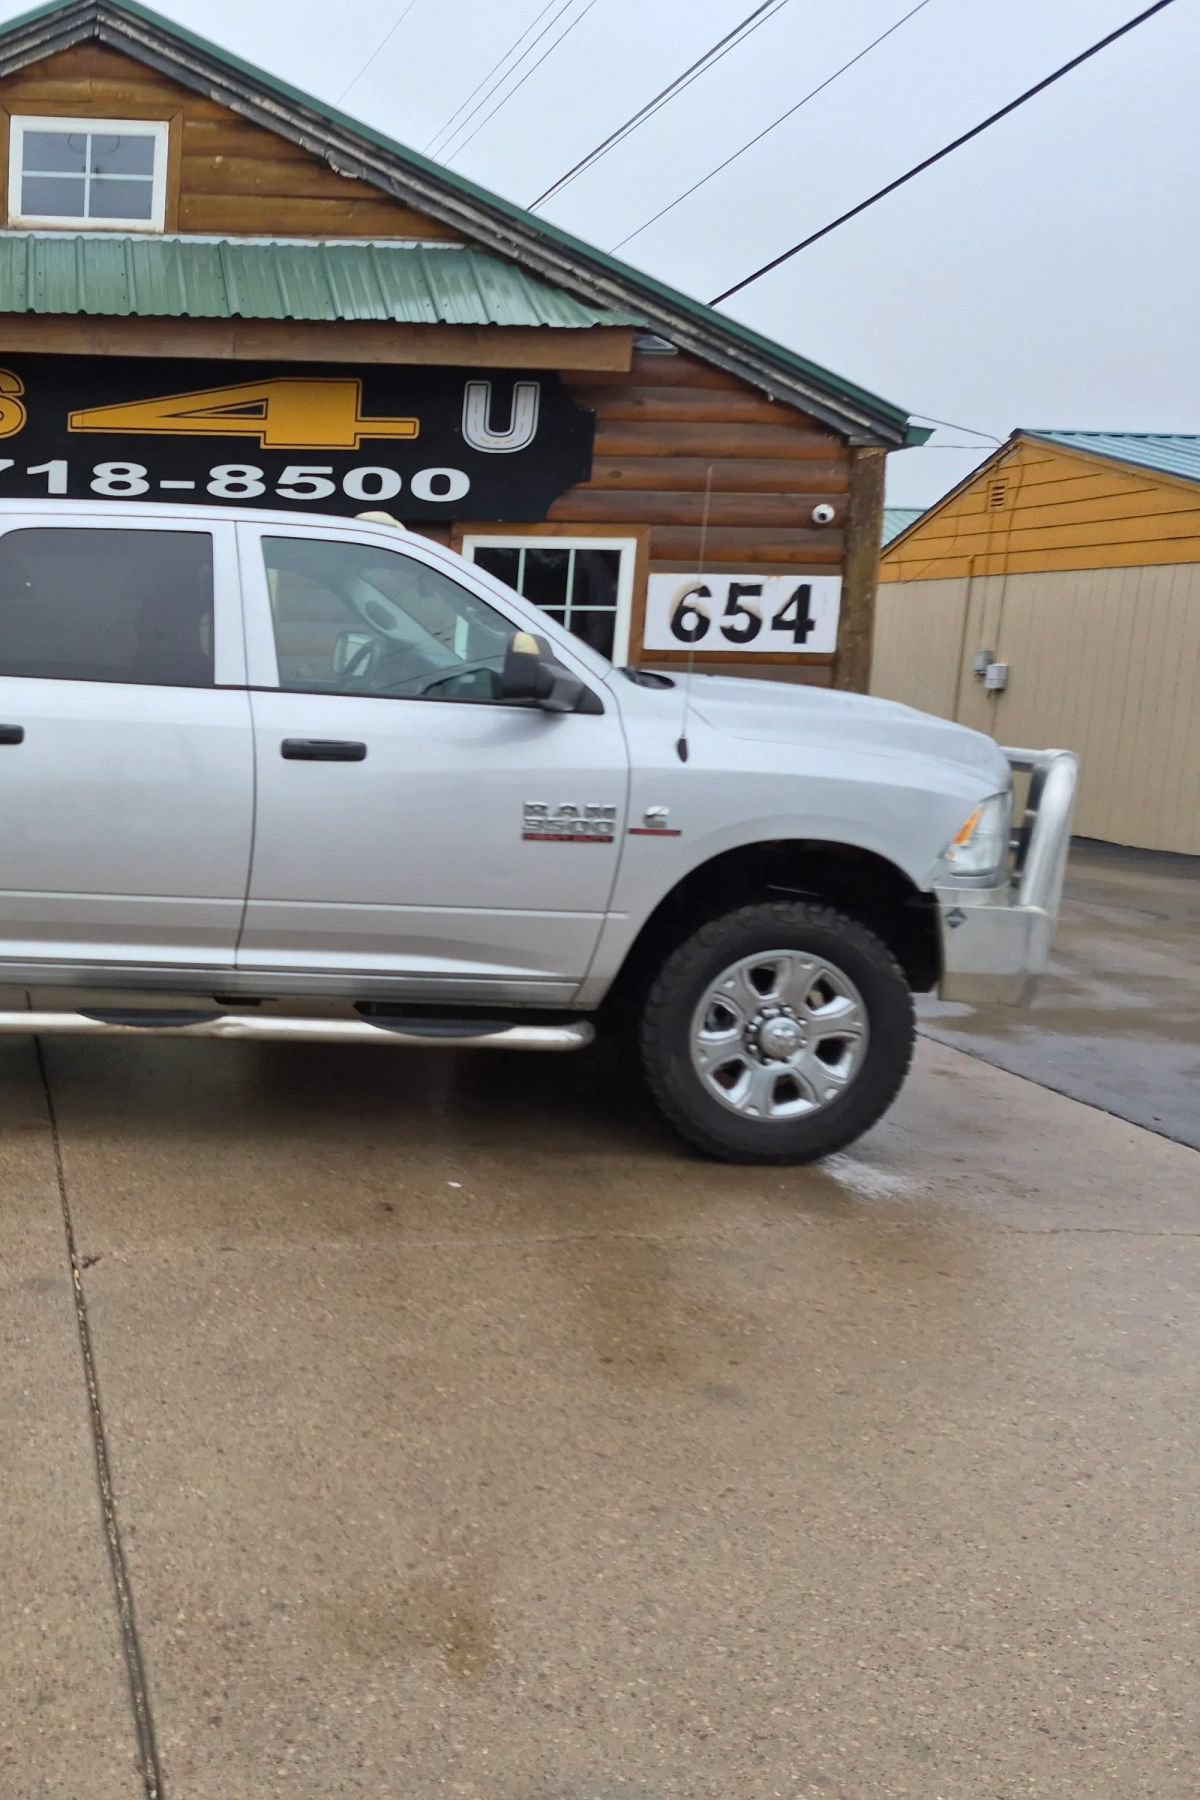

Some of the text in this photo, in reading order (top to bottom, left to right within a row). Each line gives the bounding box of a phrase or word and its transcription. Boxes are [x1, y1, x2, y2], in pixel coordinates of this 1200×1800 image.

[67, 377, 420, 450] 4
[461, 380, 541, 454] U
[670, 582, 816, 644] 654
[523, 801, 617, 818] RAM
